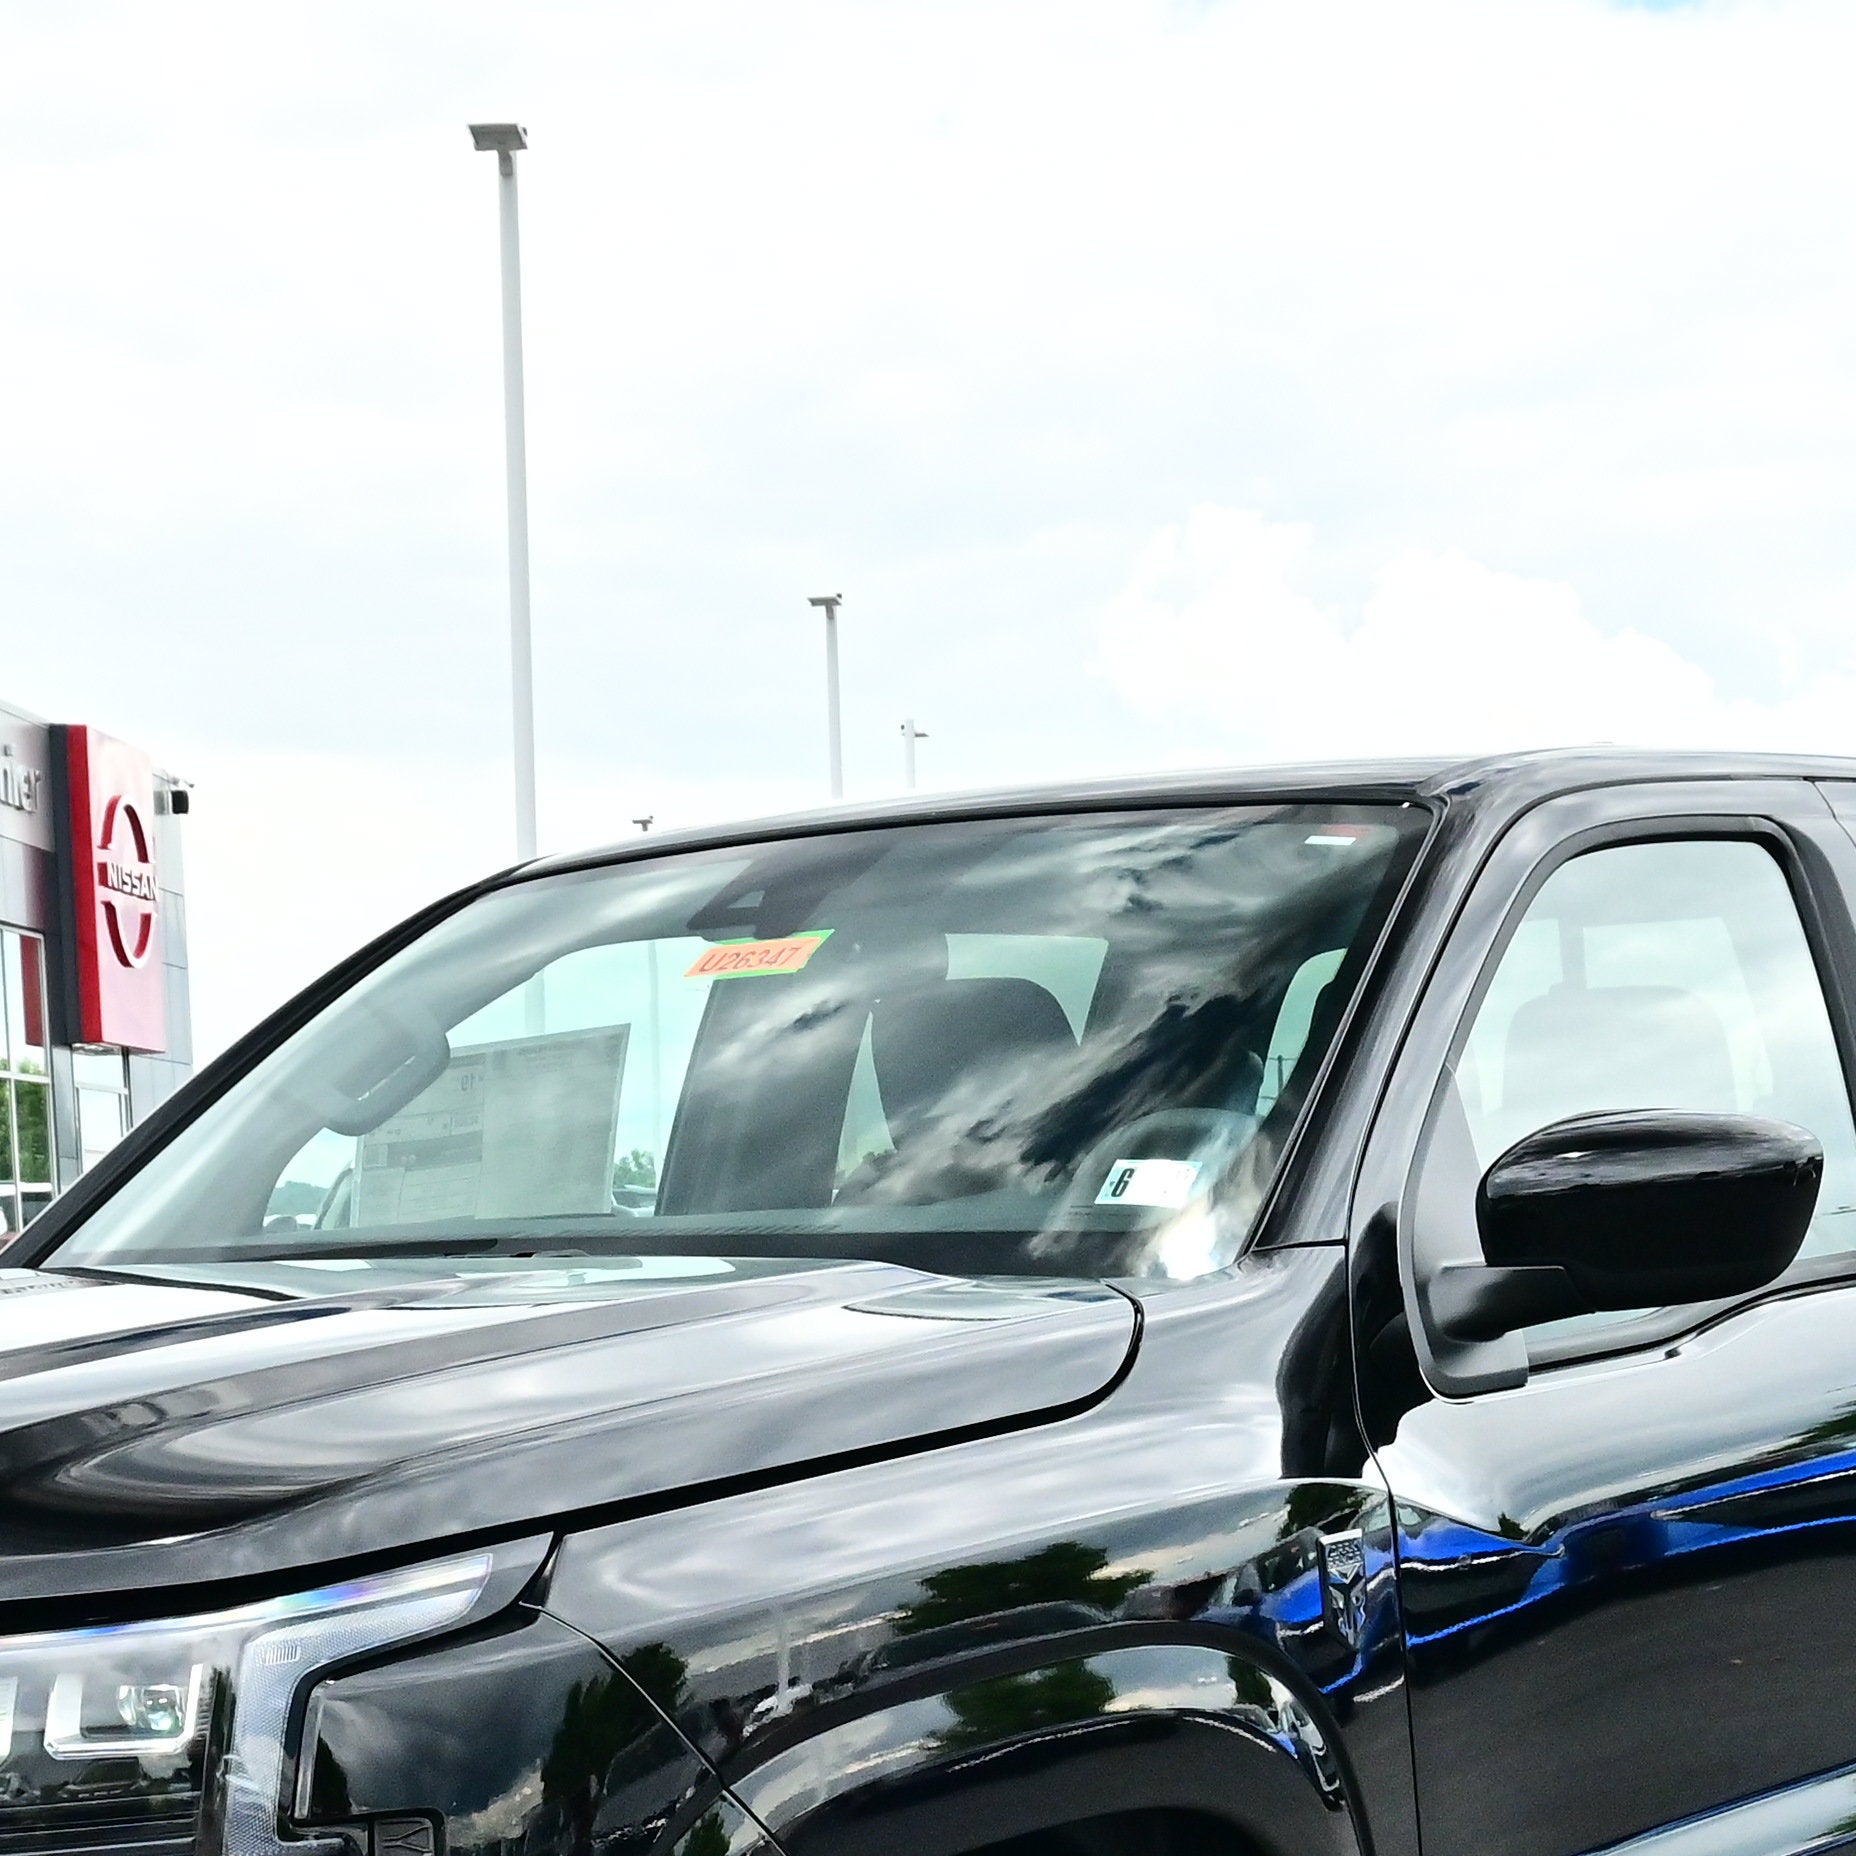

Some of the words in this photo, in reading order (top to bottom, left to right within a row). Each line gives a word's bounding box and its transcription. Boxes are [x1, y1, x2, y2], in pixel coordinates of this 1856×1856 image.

[107, 862, 159, 901] NISSAN
[699, 946, 803, 973] U26347
[1110, 1168, 1135, 1198] 6
